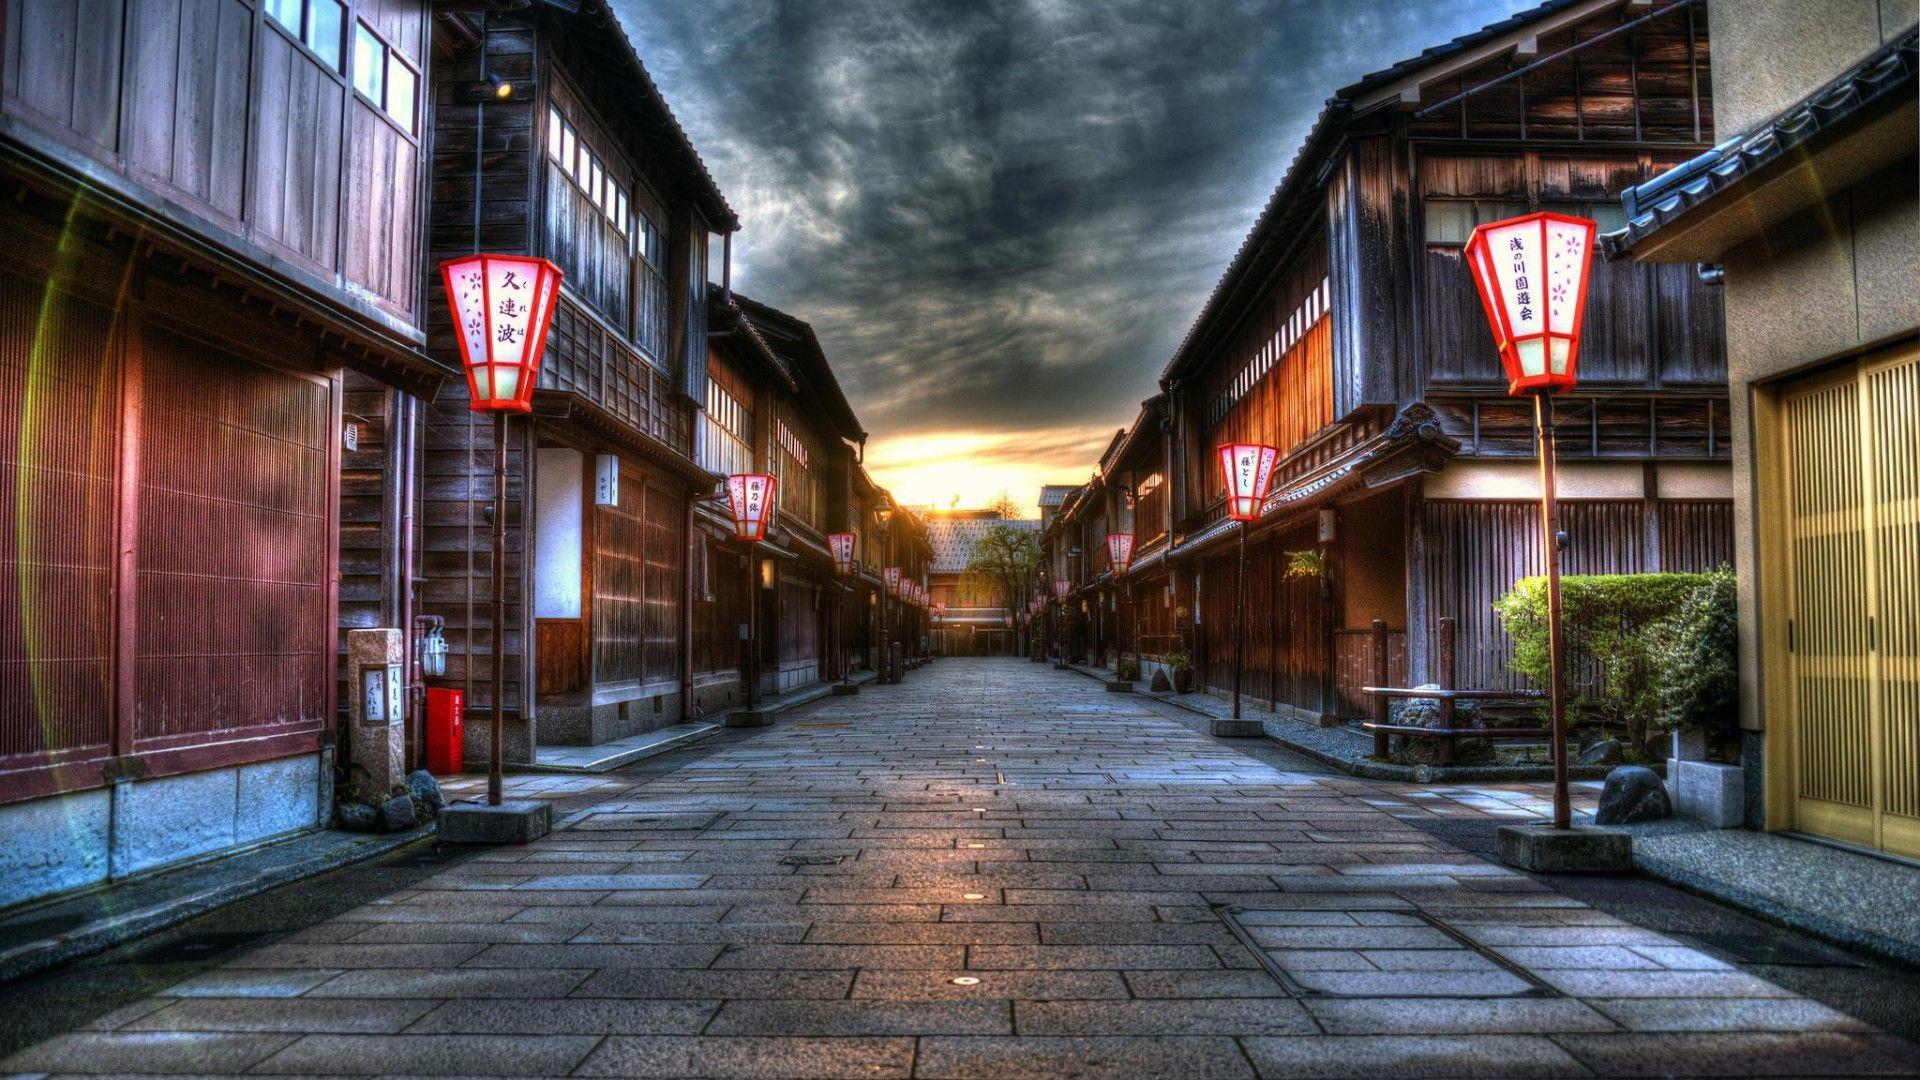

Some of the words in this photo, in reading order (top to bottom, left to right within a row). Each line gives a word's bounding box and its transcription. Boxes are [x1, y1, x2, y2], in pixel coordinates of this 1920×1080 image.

[498, 271, 520, 344] 久連波
[518, 281, 527, 336] くれは
[1510, 237, 1533, 321] 浅の川園遊会
